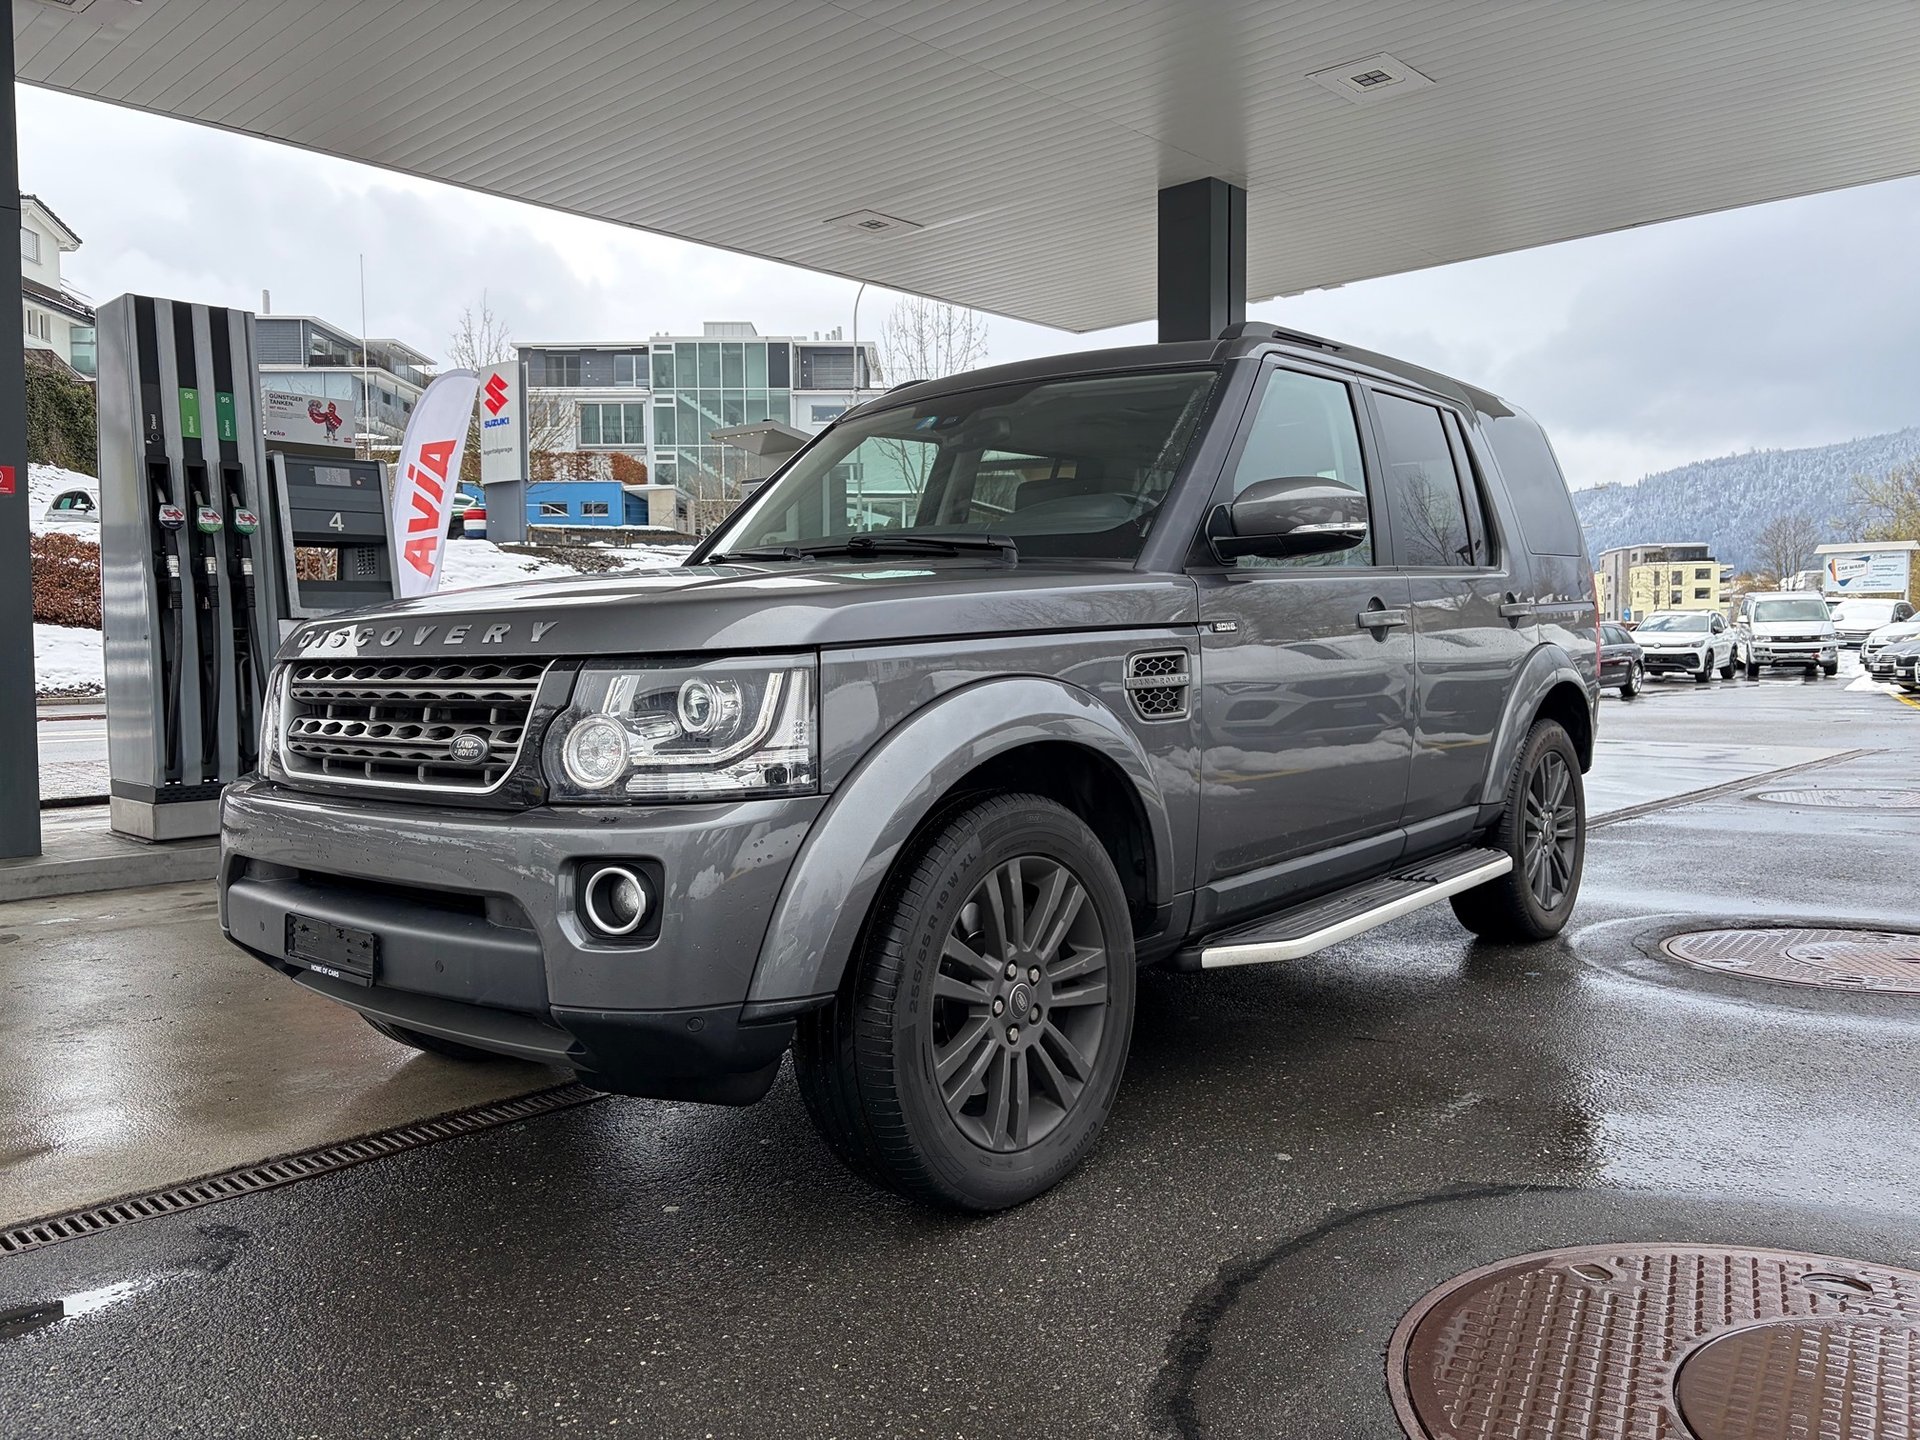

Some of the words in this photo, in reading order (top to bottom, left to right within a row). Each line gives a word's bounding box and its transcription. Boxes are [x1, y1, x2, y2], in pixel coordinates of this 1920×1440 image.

[184, 392, 194, 400] 98
[220, 396, 230, 404] 95
[269, 393, 303, 402] GÜNSTIGER
[484, 417, 510, 429] SUZUKI
[269, 429, 286, 437] reka
[329, 512, 345, 532] 4
[298, 621, 559, 649] DISCOVERY
[935, 889, 950, 911] 19
